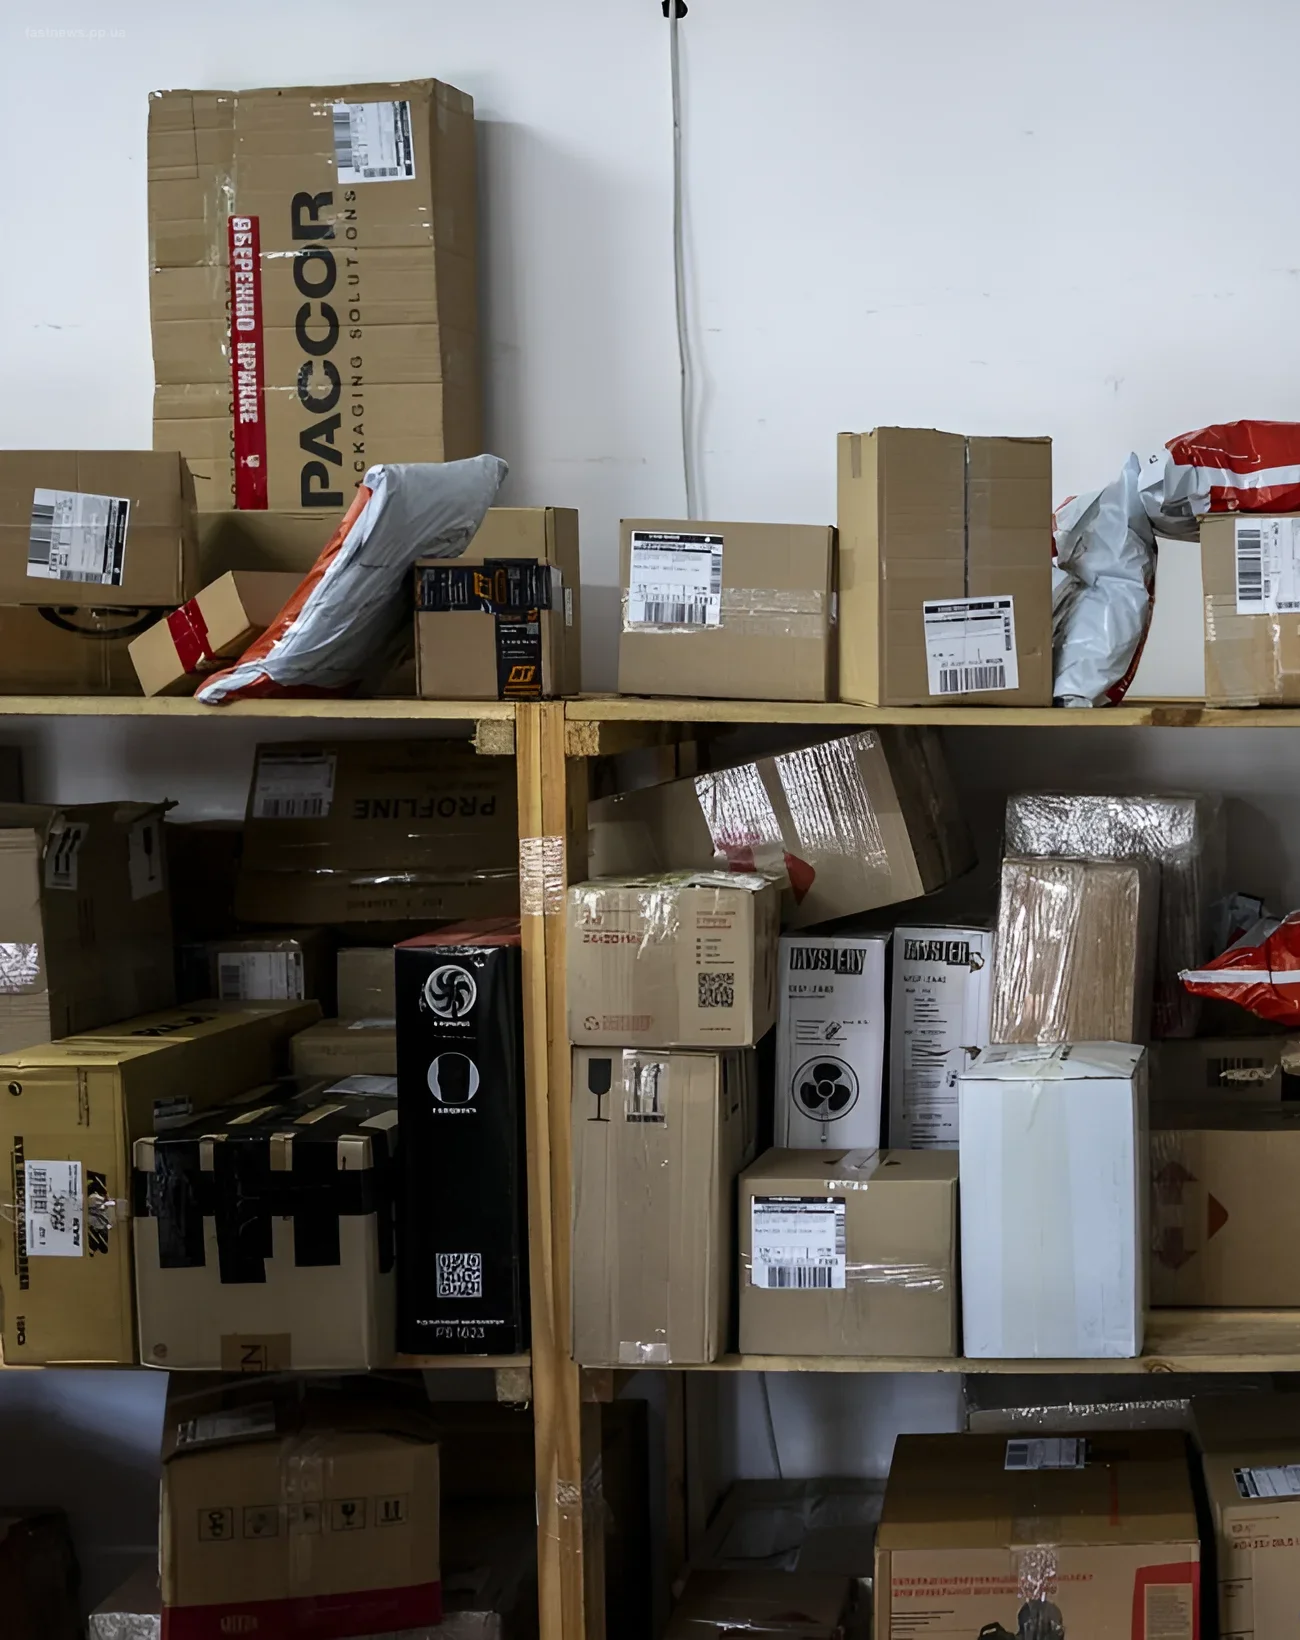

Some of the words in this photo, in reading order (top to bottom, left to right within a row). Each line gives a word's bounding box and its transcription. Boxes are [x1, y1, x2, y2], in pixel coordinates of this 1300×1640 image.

[291, 191, 343, 507] PACCOR
[350, 355, 366, 489] ACKAGING
[353, 795, 497, 820] PROFLINE
